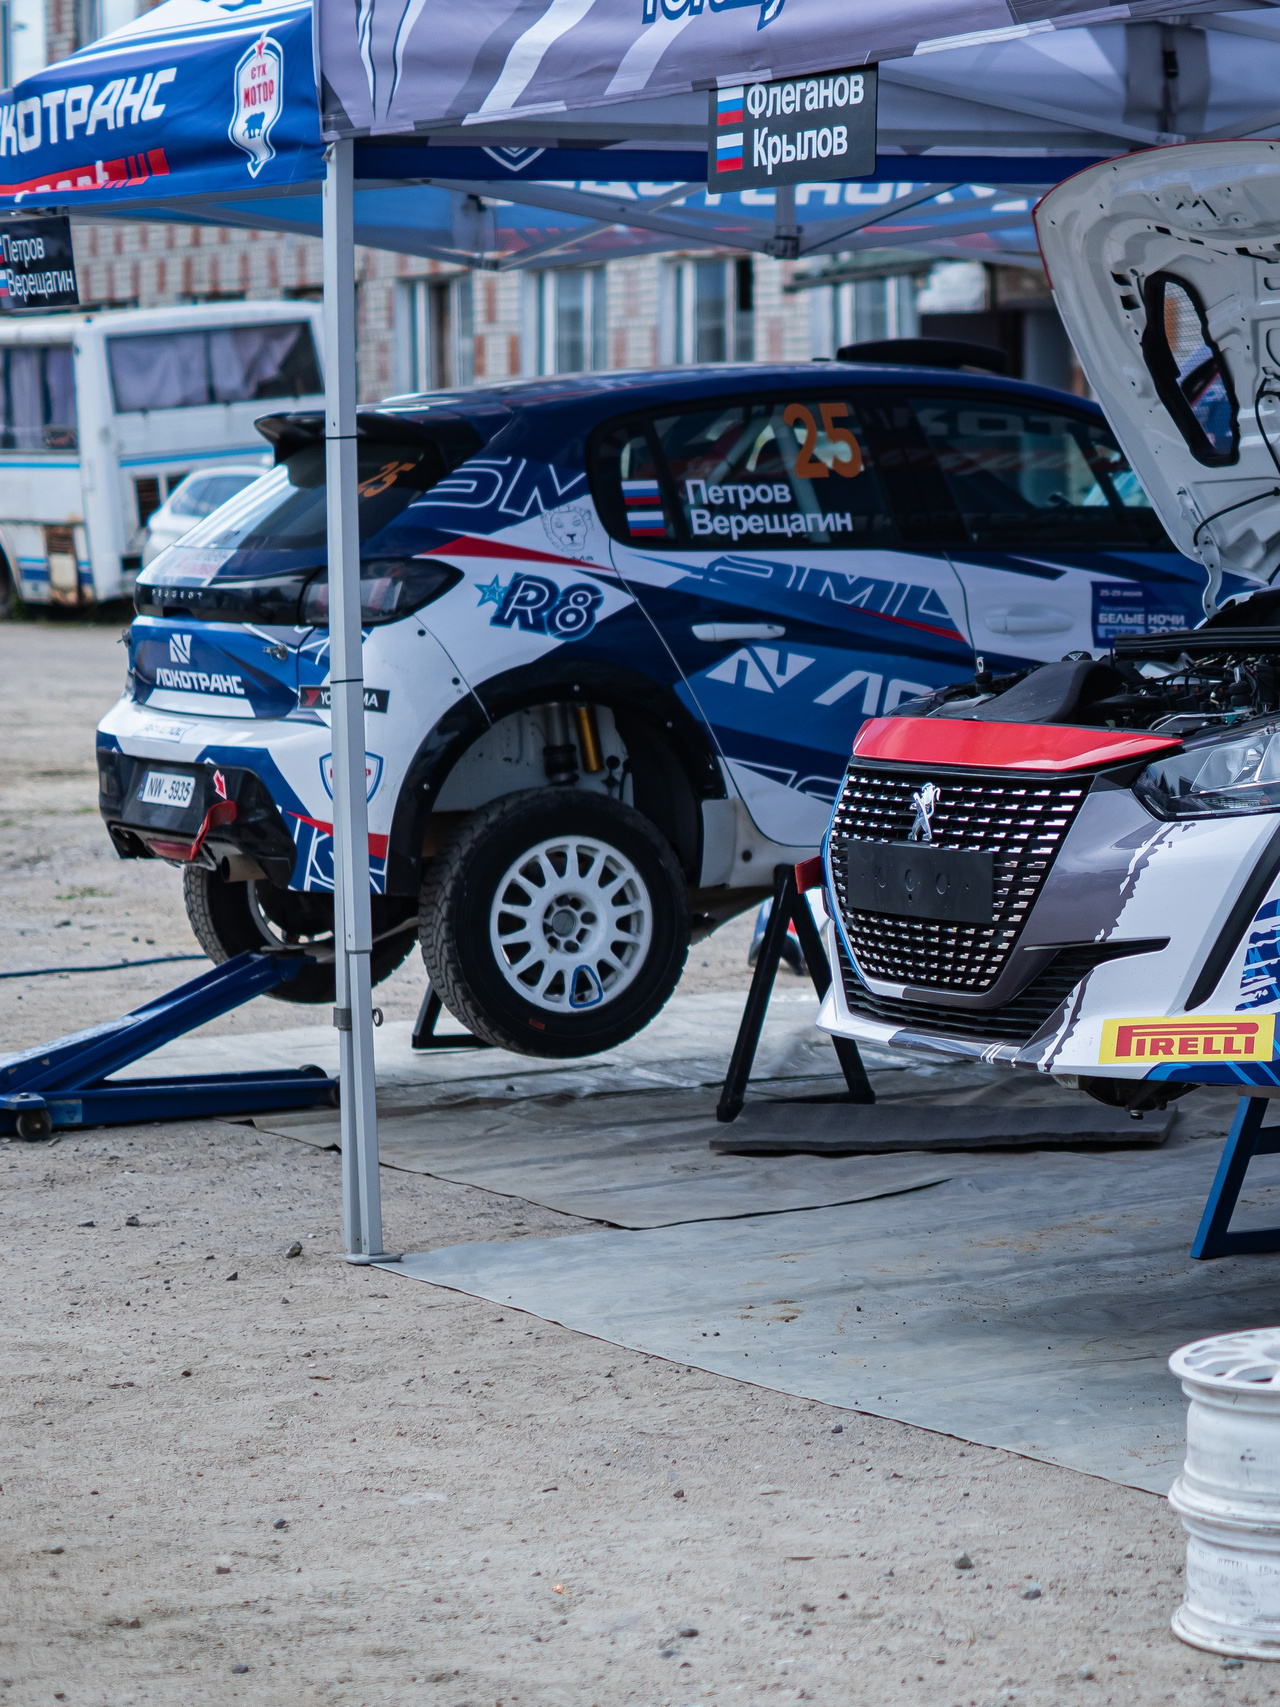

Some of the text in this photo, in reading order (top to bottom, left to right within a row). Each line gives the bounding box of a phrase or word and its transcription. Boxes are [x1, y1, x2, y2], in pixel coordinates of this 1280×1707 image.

[250, 62, 267, 77] СТК
[243, 81, 275, 108] МОТОР
[746, 74, 865, 119] Флеганов
[753, 125, 848, 175] Крылов
[2, 234, 46, 268] Петров
[6, 268, 75, 304] Верещагин
[783, 403, 862, 478] 25
[685, 479, 792, 510] Петров
[690, 508, 853, 541] Верещагин
[151, 588, 204, 600] PEUGEOT
[490, 572, 604, 642] R8
[1099, 613, 1185, 625] БЕЛЫЕ НОЧИ
[156, 667, 245, 695] ЛОКОТРАНС
[1115, 1022, 1260, 1057] PIRELLI
